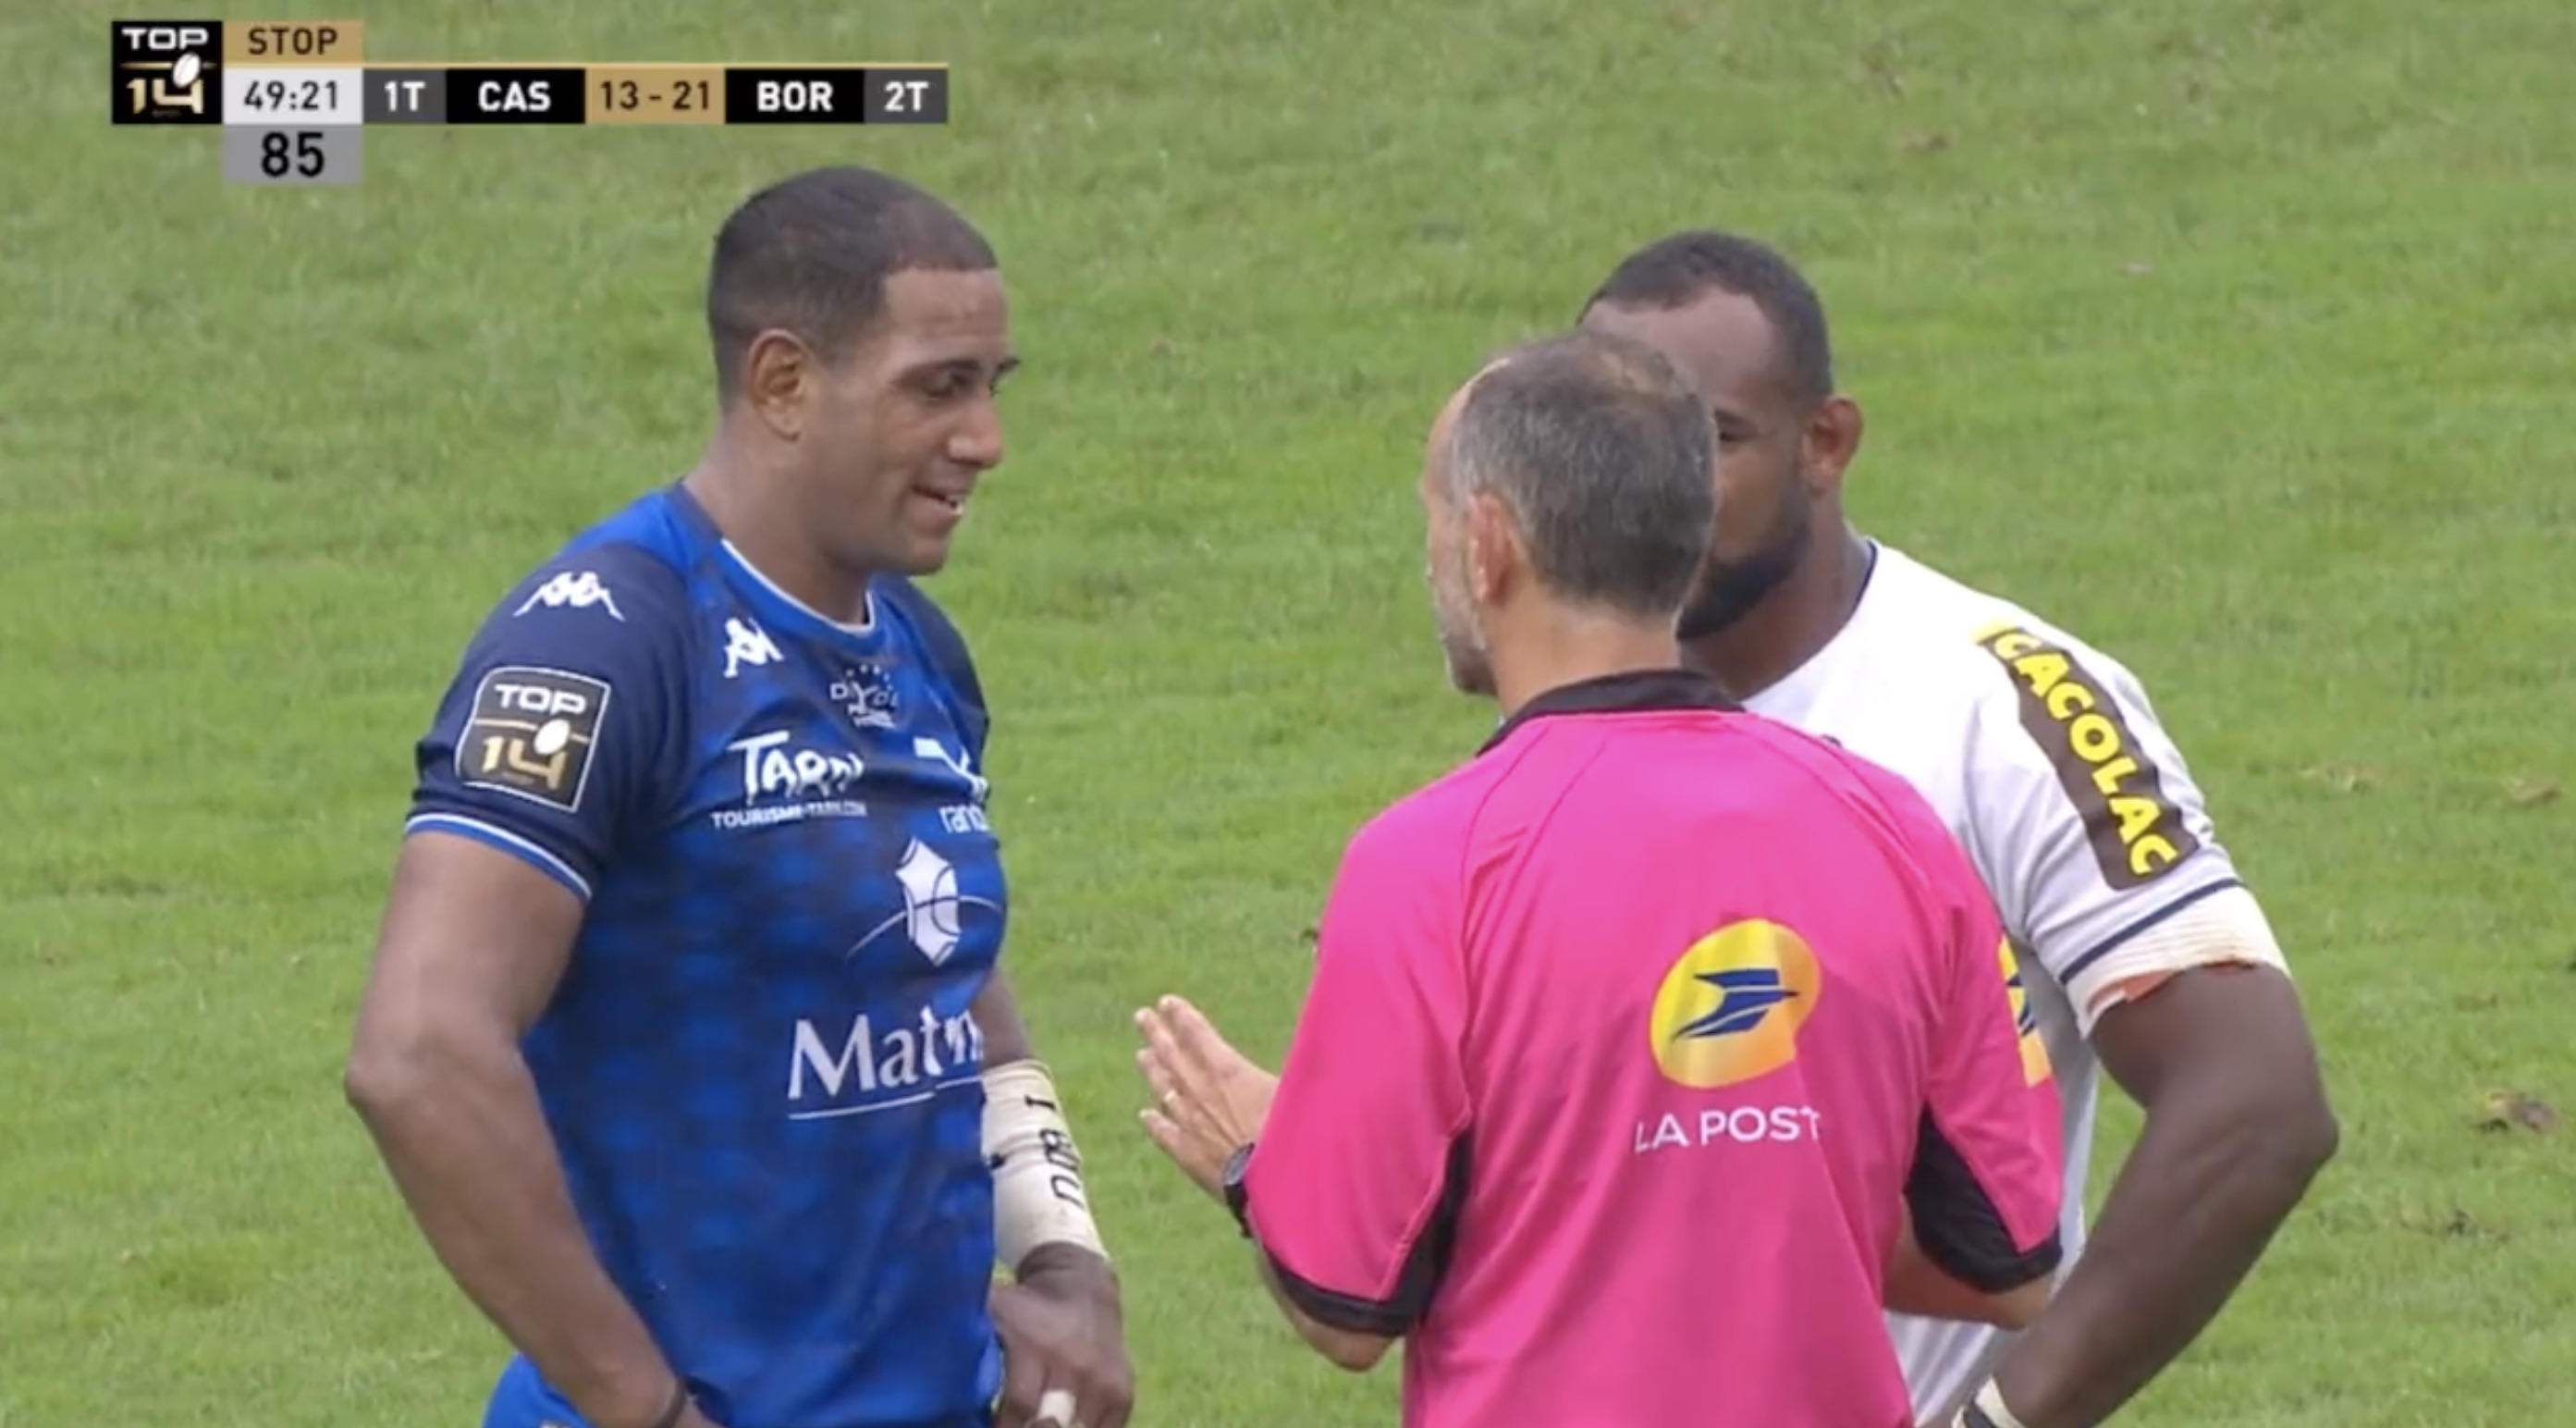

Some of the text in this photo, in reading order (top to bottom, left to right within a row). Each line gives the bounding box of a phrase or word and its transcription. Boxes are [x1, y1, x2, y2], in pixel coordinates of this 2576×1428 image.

[494, 683, 587, 716] TOP
[481, 735, 568, 792] 14
[1993, 632, 2179, 877] CACOLAC
[1634, 1113, 1690, 1153] LA
